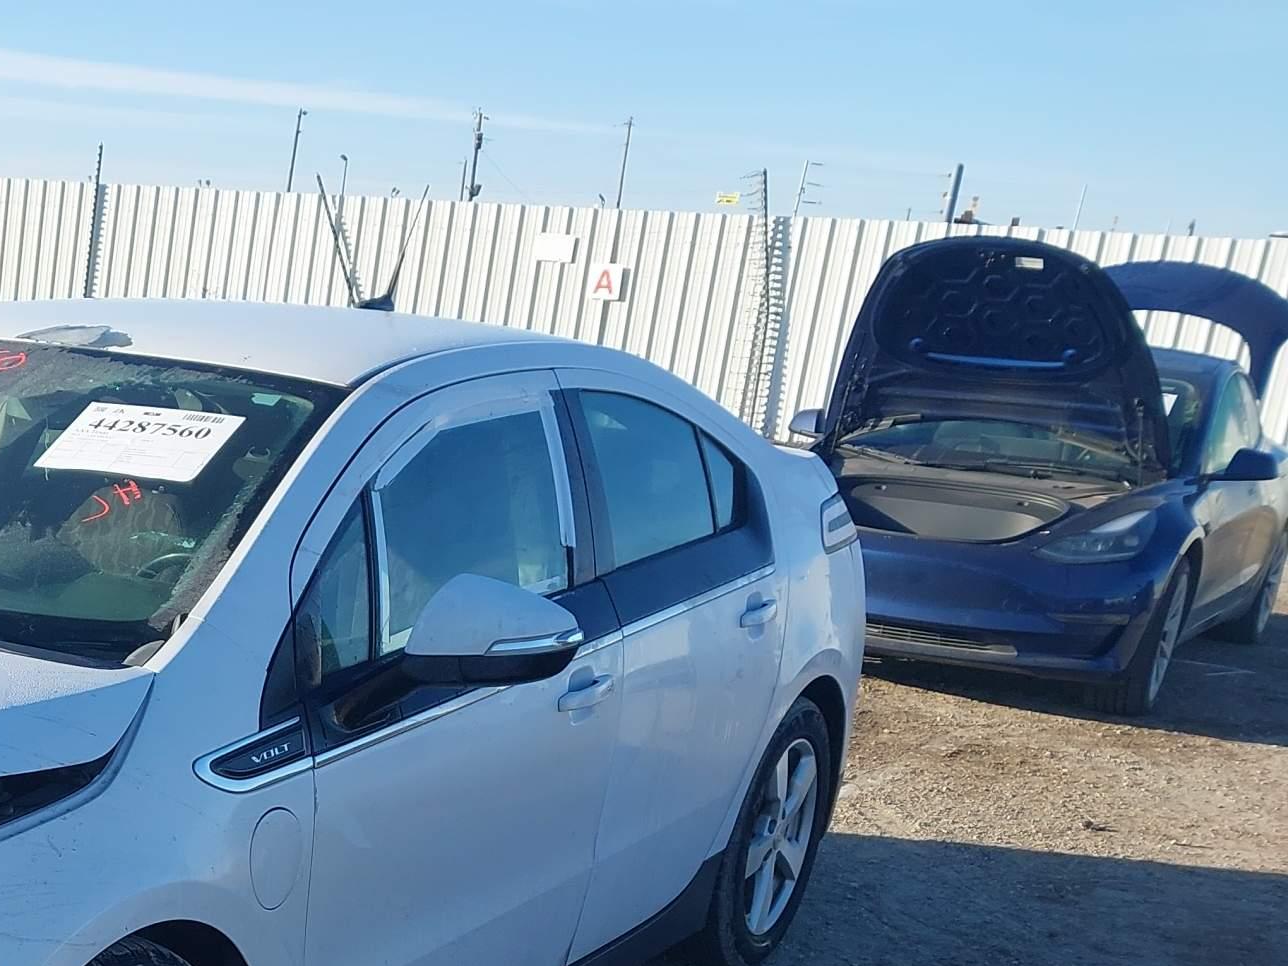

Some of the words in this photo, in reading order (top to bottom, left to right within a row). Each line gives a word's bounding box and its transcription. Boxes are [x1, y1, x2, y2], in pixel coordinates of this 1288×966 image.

[593, 269, 614, 295] A
[88, 417, 212, 441] 44287560
[250, 742, 292, 763] VOLT
